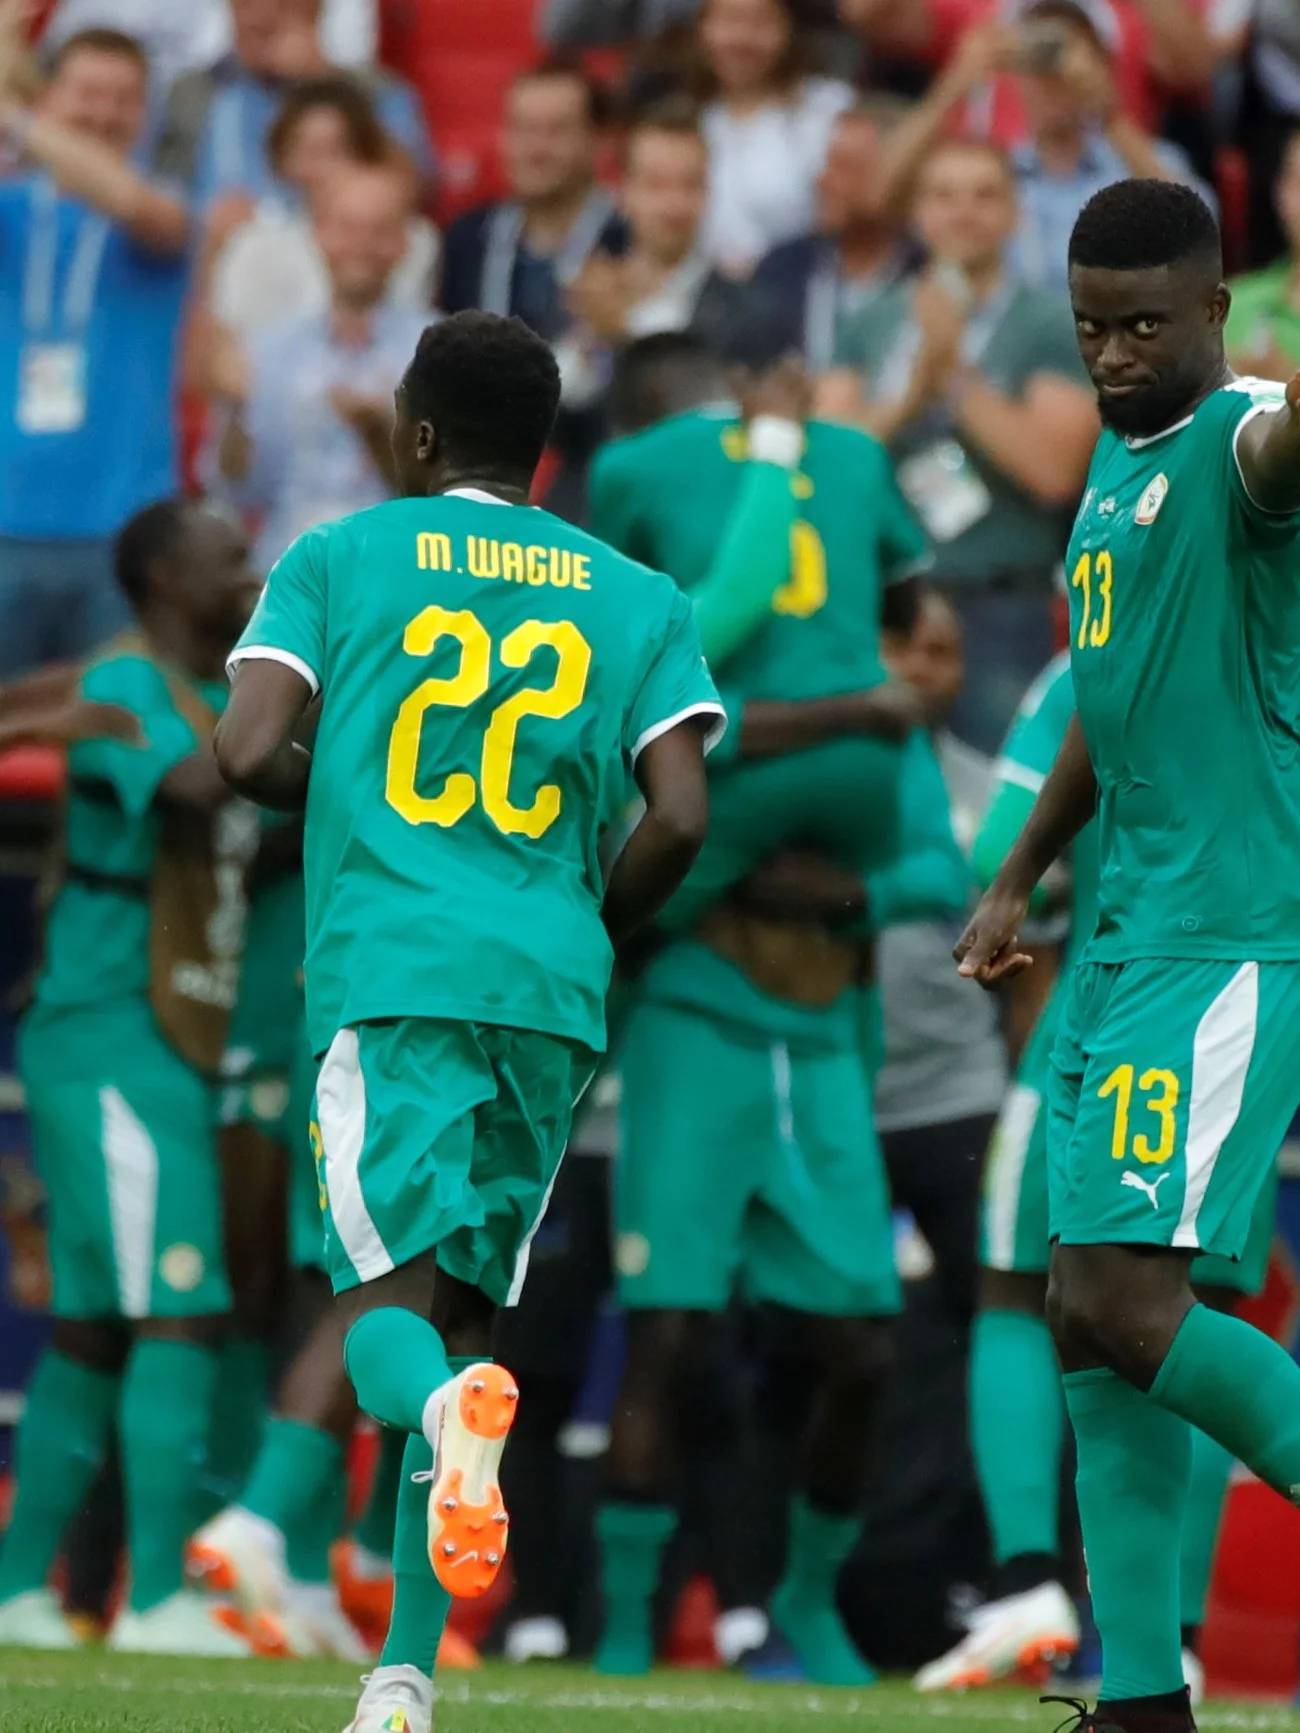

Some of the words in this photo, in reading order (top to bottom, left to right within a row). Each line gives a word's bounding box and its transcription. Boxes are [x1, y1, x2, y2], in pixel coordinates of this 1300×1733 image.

[416, 531, 592, 591] M.WAGUE
[1071, 549, 1113, 649] 13
[385, 605, 593, 839] 22
[1098, 1063, 1181, 1165] 13
